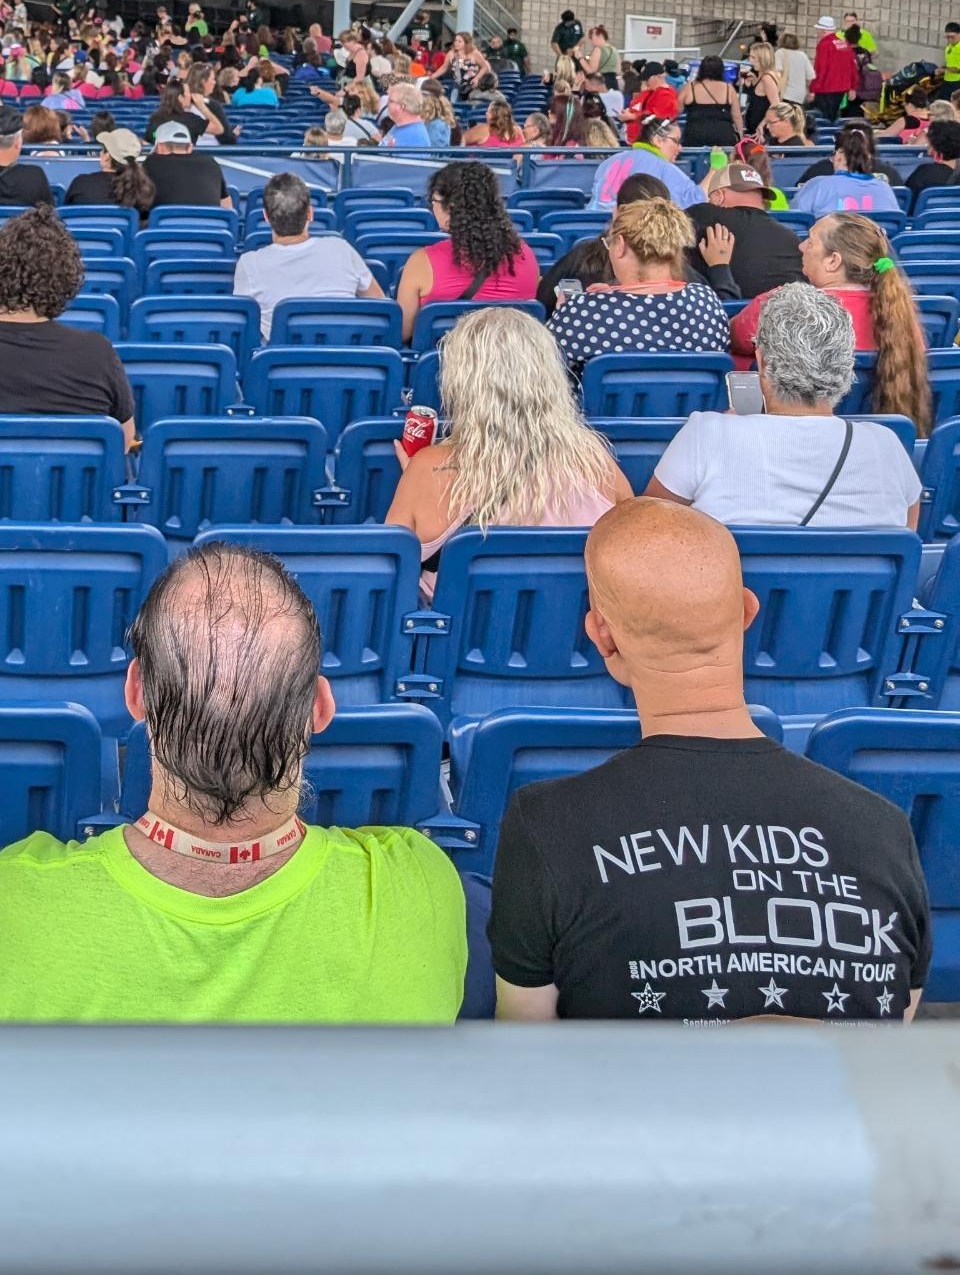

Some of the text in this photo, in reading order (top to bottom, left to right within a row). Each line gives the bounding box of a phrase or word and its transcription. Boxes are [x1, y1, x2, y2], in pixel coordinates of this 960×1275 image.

[190, 844, 222, 858] CANADA
[276, 829, 297, 847] CANADA
[592, 823, 830, 884] NEW KIDS
[732, 869, 862, 900] ON THE
[674, 895, 902, 956] BLOCK
[639, 953, 722, 980] NORTH
[726, 951, 845, 979] AMERICAN
[851, 961, 896, 983] TOUR
